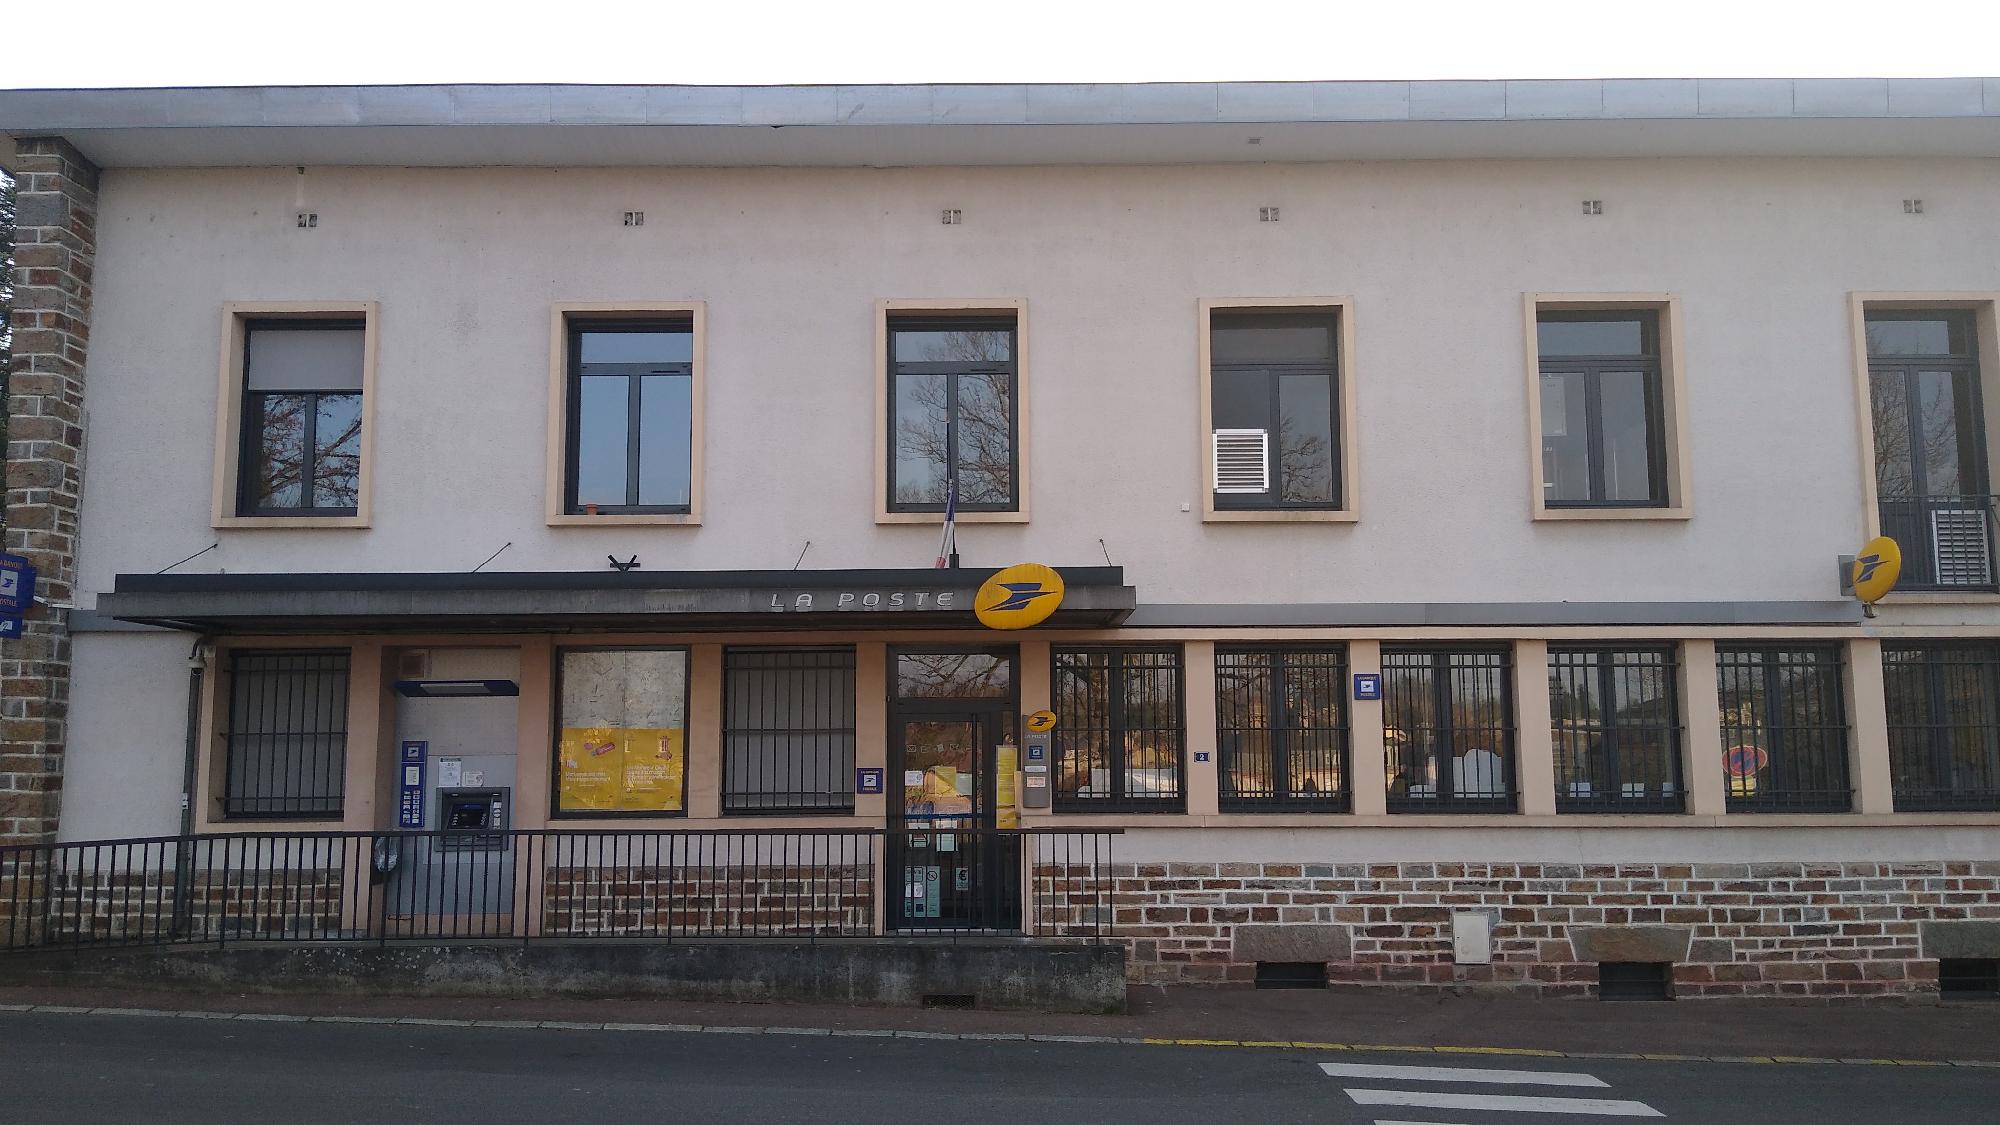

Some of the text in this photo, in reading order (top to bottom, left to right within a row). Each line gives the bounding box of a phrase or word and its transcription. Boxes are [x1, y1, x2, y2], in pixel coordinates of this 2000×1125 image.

[771, 592, 954, 607] LA POSTE
[1199, 753, 1205, 761] 2
